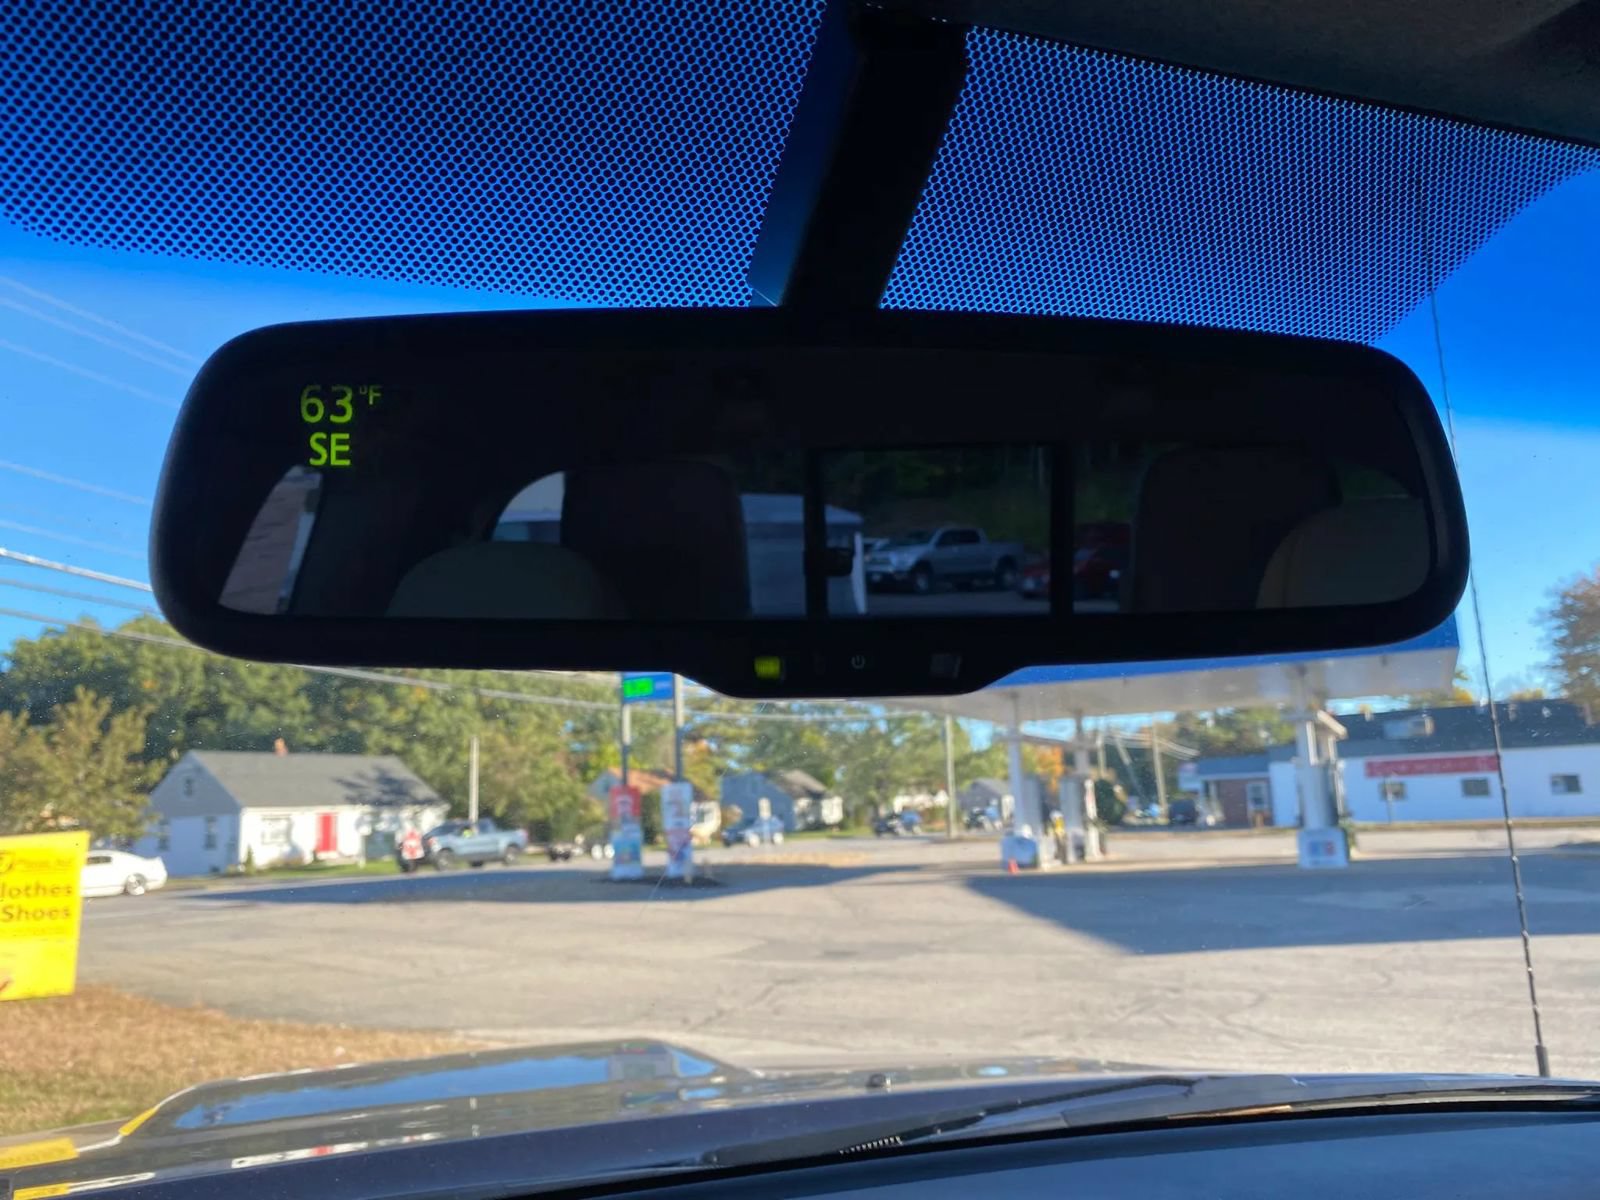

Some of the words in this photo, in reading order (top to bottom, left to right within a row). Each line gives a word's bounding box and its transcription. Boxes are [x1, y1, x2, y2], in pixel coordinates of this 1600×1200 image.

[309, 431, 351, 466] SE
[0, 880, 73, 899] lothes
[1, 904, 72, 923] Shoes
